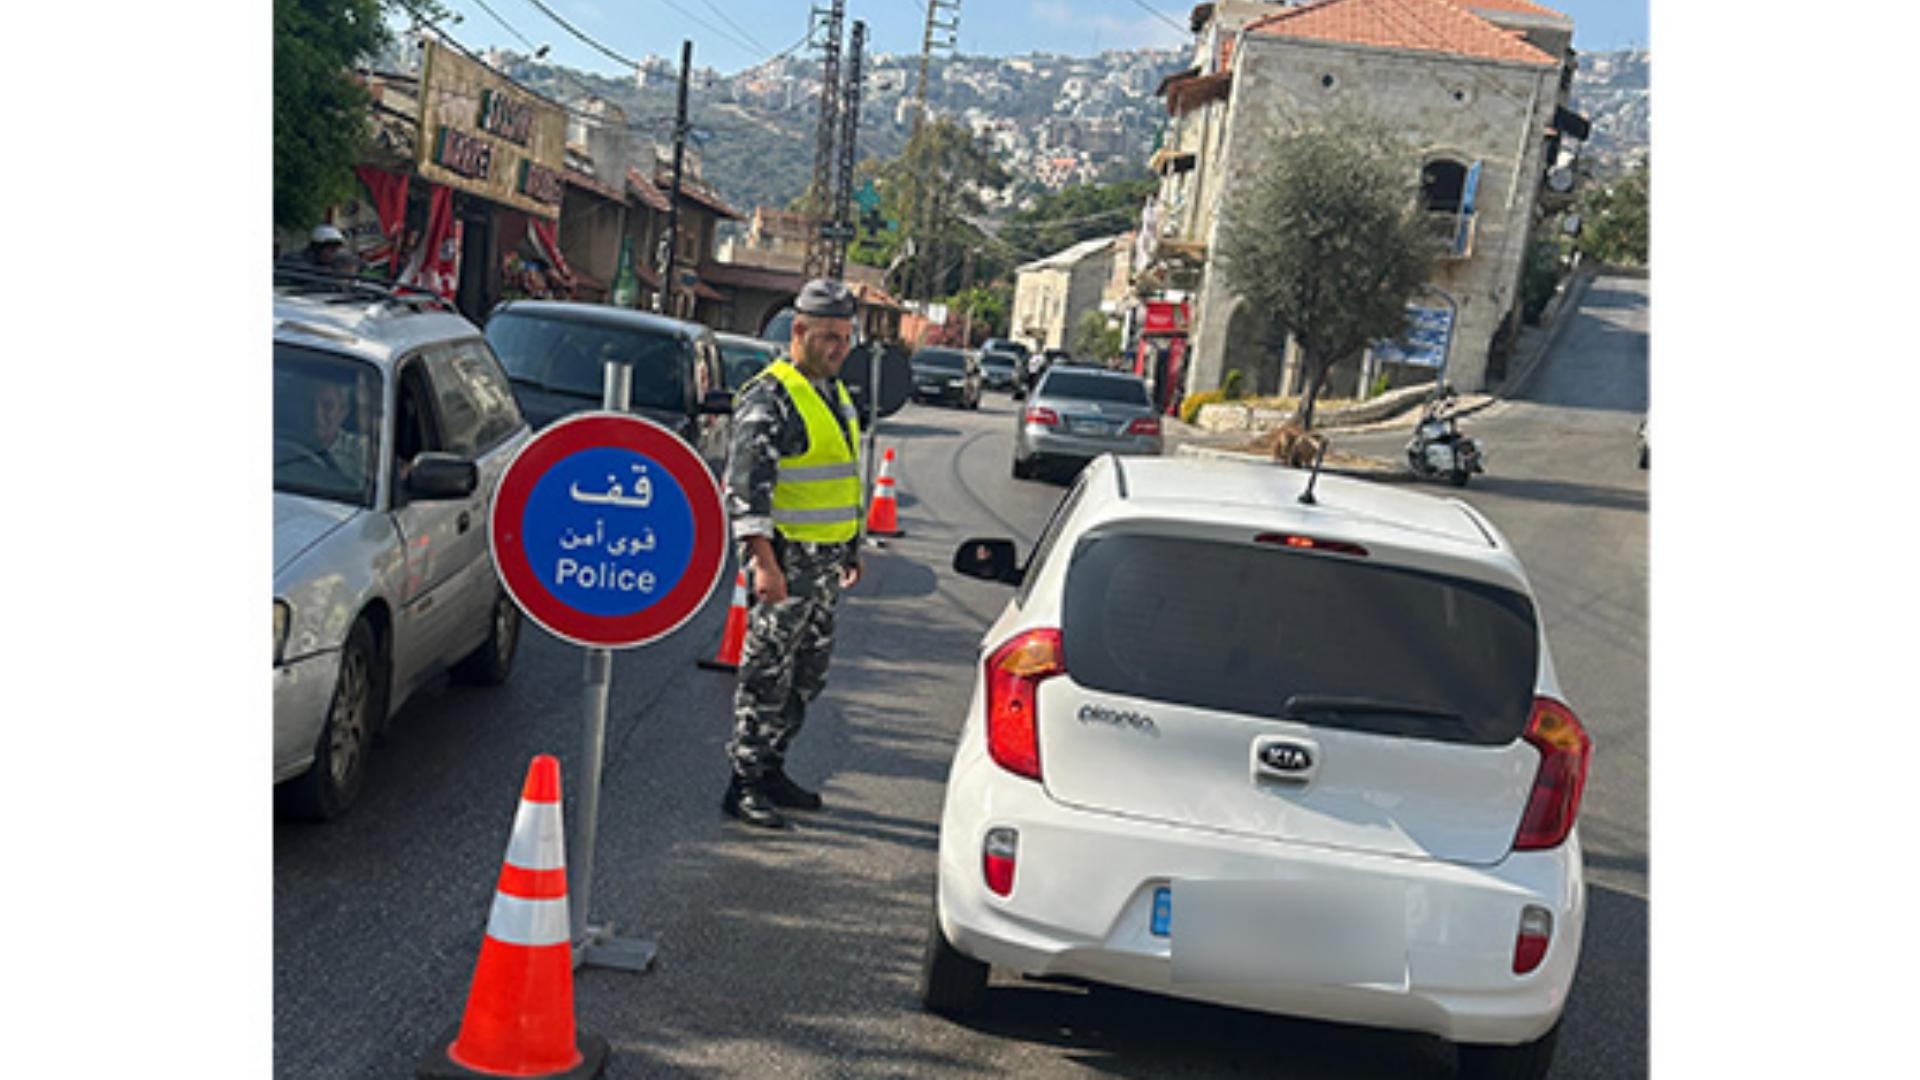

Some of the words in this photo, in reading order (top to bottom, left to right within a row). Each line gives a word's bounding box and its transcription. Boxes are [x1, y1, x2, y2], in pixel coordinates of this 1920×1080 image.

[569, 463, 654, 507] قف
[559, 517, 604, 550] أمن
[555, 557, 657, 594] Police
[1268, 747, 1308, 769] KIA
